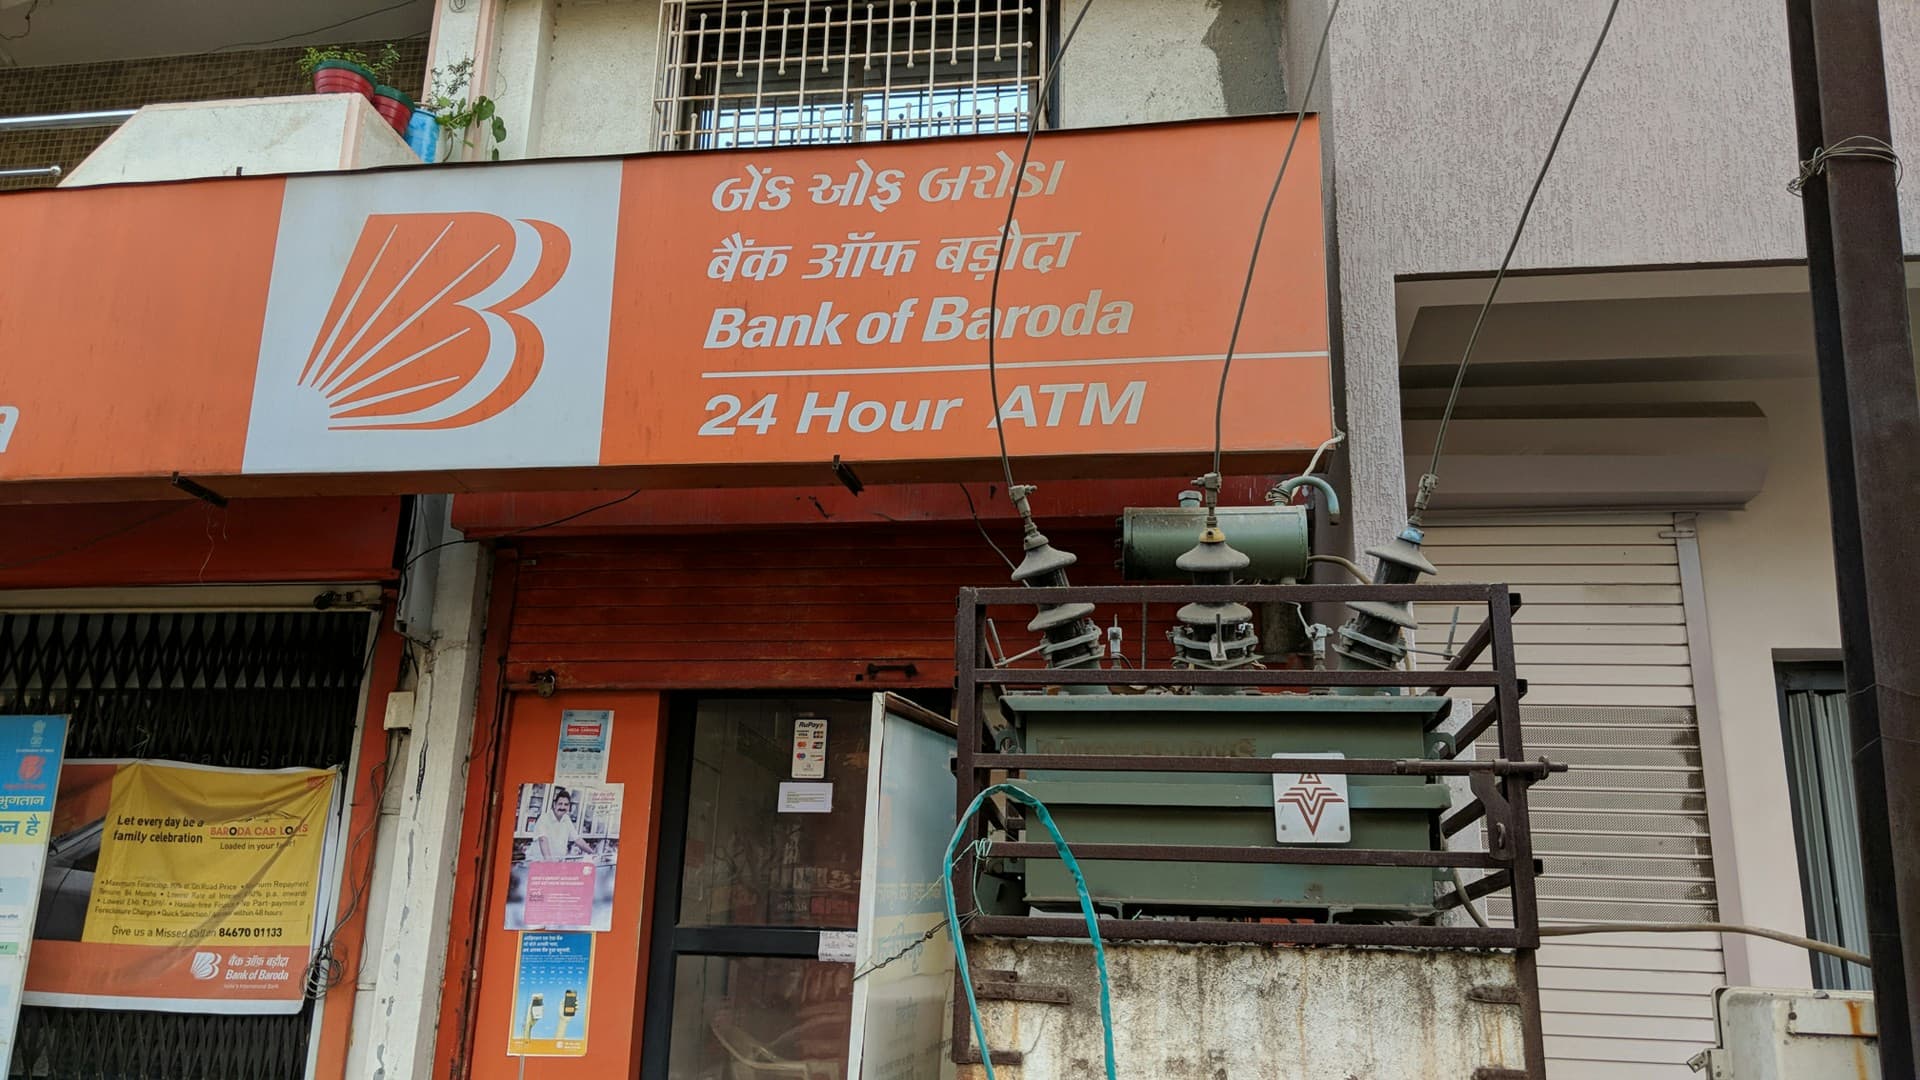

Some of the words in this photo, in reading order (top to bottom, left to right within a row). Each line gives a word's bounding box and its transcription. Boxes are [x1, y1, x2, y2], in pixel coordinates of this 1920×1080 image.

[711, 164, 795, 212] બેંક
[918, 150, 1066, 202] બરોડા
[707, 231, 793, 282] बैंक
[801, 231, 921, 279] ऑफ
[703, 301, 849, 349] Bank
[855, 298, 919, 343] of
[921, 289, 1134, 343] Baroda
[698, 393, 778, 437] 24
[796, 391, 964, 434] Hour
[987, 380, 1148, 430] ATM
[117, 816, 135, 826] Let
[137, 817, 161, 828] every
[164, 817, 181, 829] day
[183, 818, 195, 827] be
[113, 830, 147, 843] family
[150, 831, 203, 843] celebration
[210, 827, 250, 836] BARODA
[254, 826, 276, 836] CAR
[220, 842, 246, 850] Loaded
[257, 843, 274, 851] your
[112, 925, 131, 936] Give
[134, 927, 144, 937] us
[147, 928, 153, 937] a
[155, 928, 187, 938] Missed
[219, 928, 251, 937] 84670
[254, 928, 283, 937] 01133
[225, 968, 248, 980] Bank
[248, 968, 258, 980] of
[258, 968, 289, 980] Baroda
